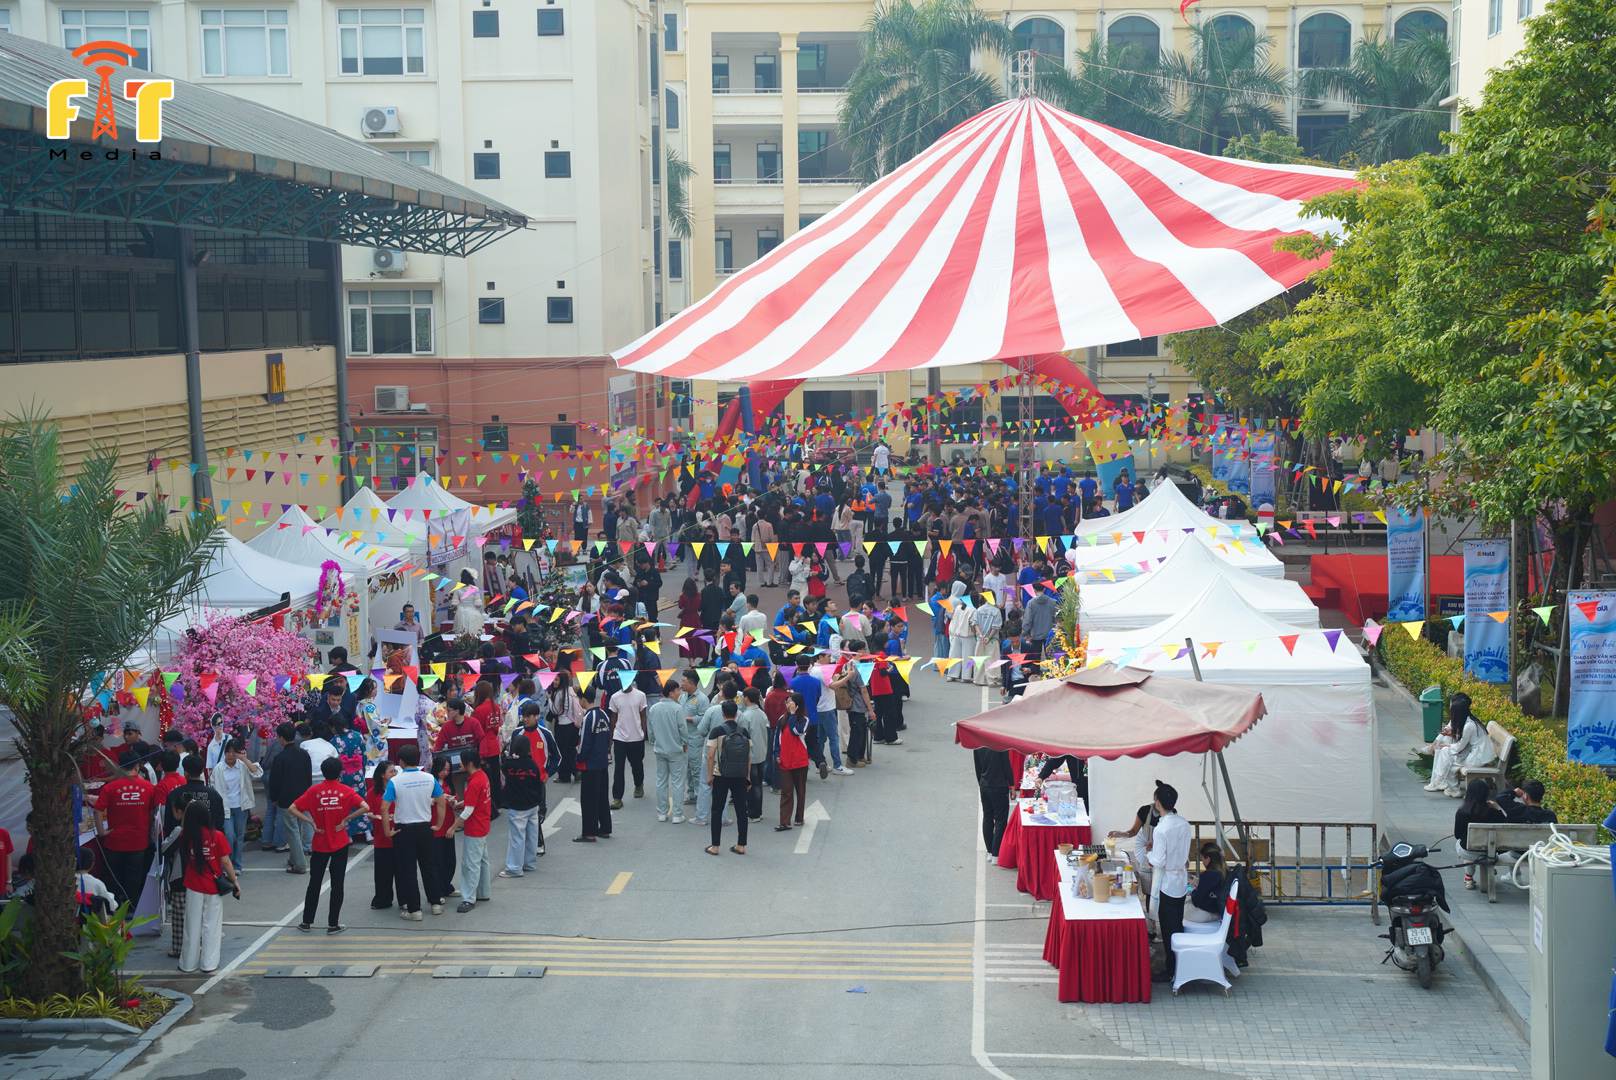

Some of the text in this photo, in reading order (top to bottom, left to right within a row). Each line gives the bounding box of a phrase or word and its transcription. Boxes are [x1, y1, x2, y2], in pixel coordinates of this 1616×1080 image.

[1581, 640, 1600, 650] Ngày
[122, 792, 140, 800] C2
[320, 796, 339, 806] C2
